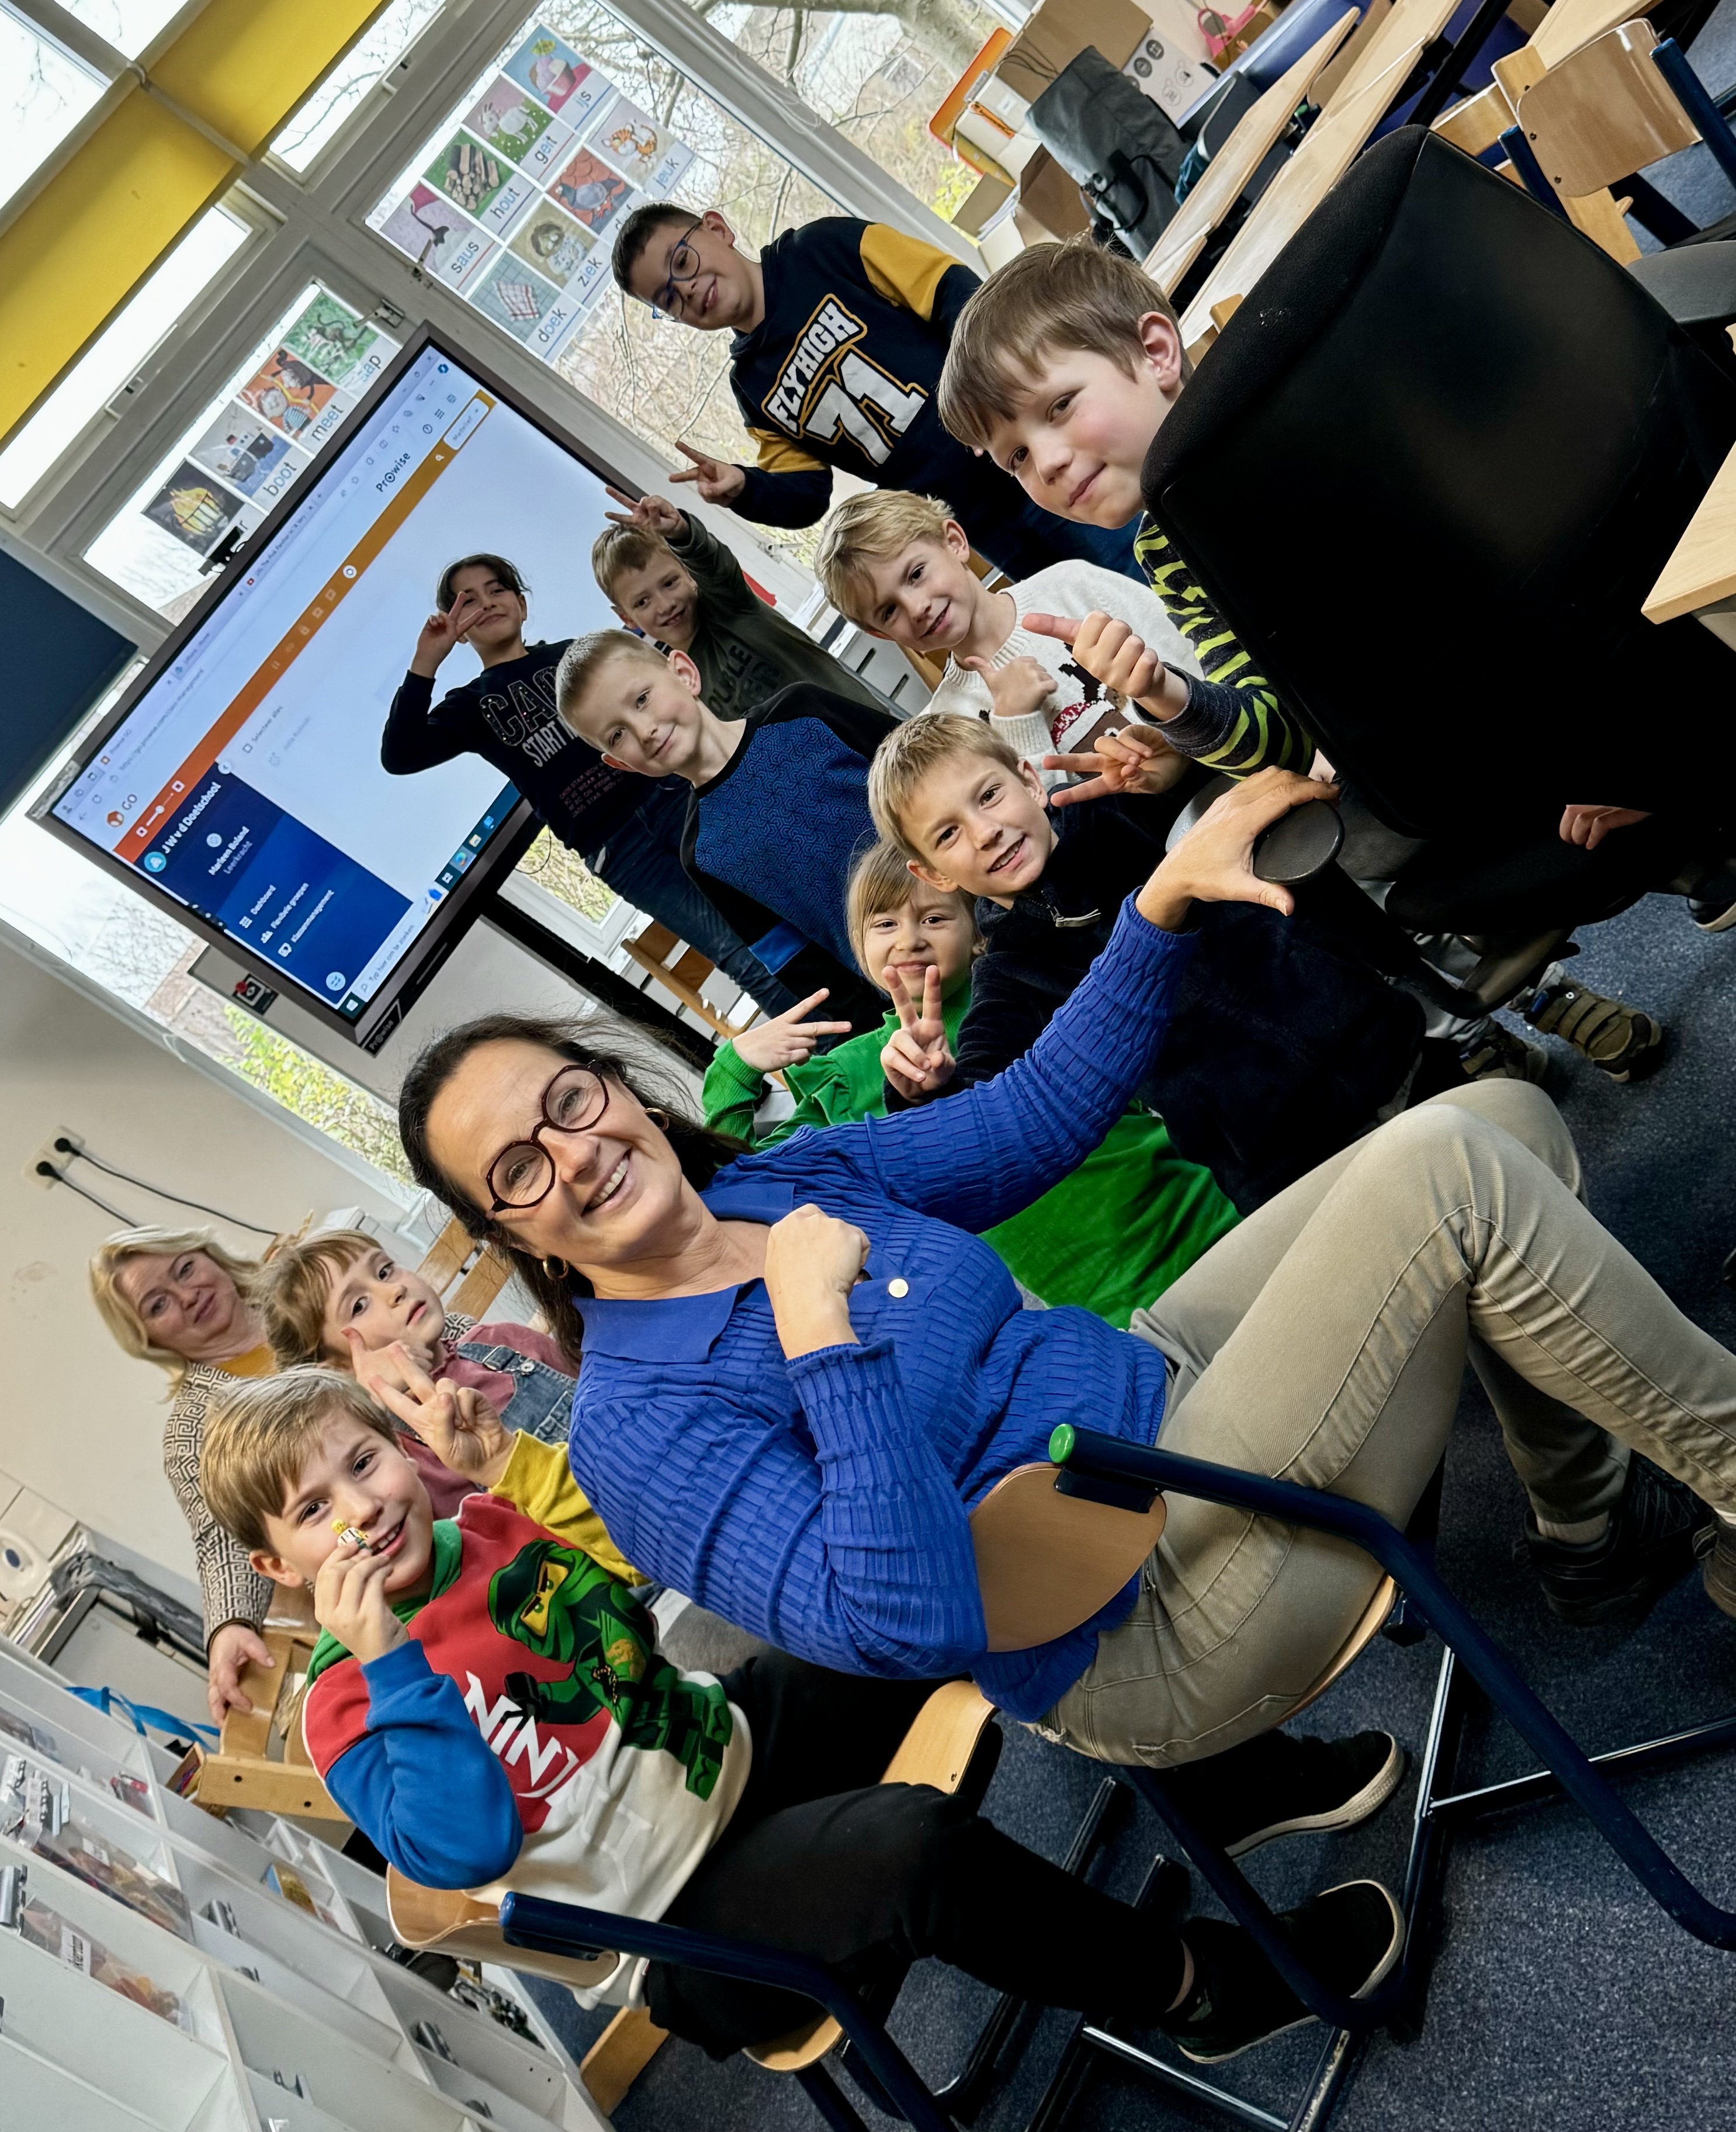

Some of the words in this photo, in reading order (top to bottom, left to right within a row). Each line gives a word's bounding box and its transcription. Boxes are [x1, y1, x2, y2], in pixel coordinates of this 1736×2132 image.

[534, 135, 558, 164] geit
[655, 157, 680, 189] jeuk
[490, 187, 520, 220] hout
[451, 240, 479, 274] saus
[577, 257, 602, 288] ziek
[538, 307, 567, 343] doek
[311, 404, 344, 442] meet
[805, 351, 926, 465] 71
[263, 462, 297, 497] boot
[376, 451, 411, 493] Prowise
[522, 721, 562, 767] START
[121, 793, 138, 811] GO
[165, 835, 178, 847] W
[224, 839, 252, 874] Leerkracht
[250, 884, 276, 915] Dashboard
[369, 971, 380, 982] Typ
[377, 960, 387, 972] hier
[386, 950, 396, 960] om
[398, 923, 415, 944] zoeken
[369, 1019, 394, 1050] Prowise
